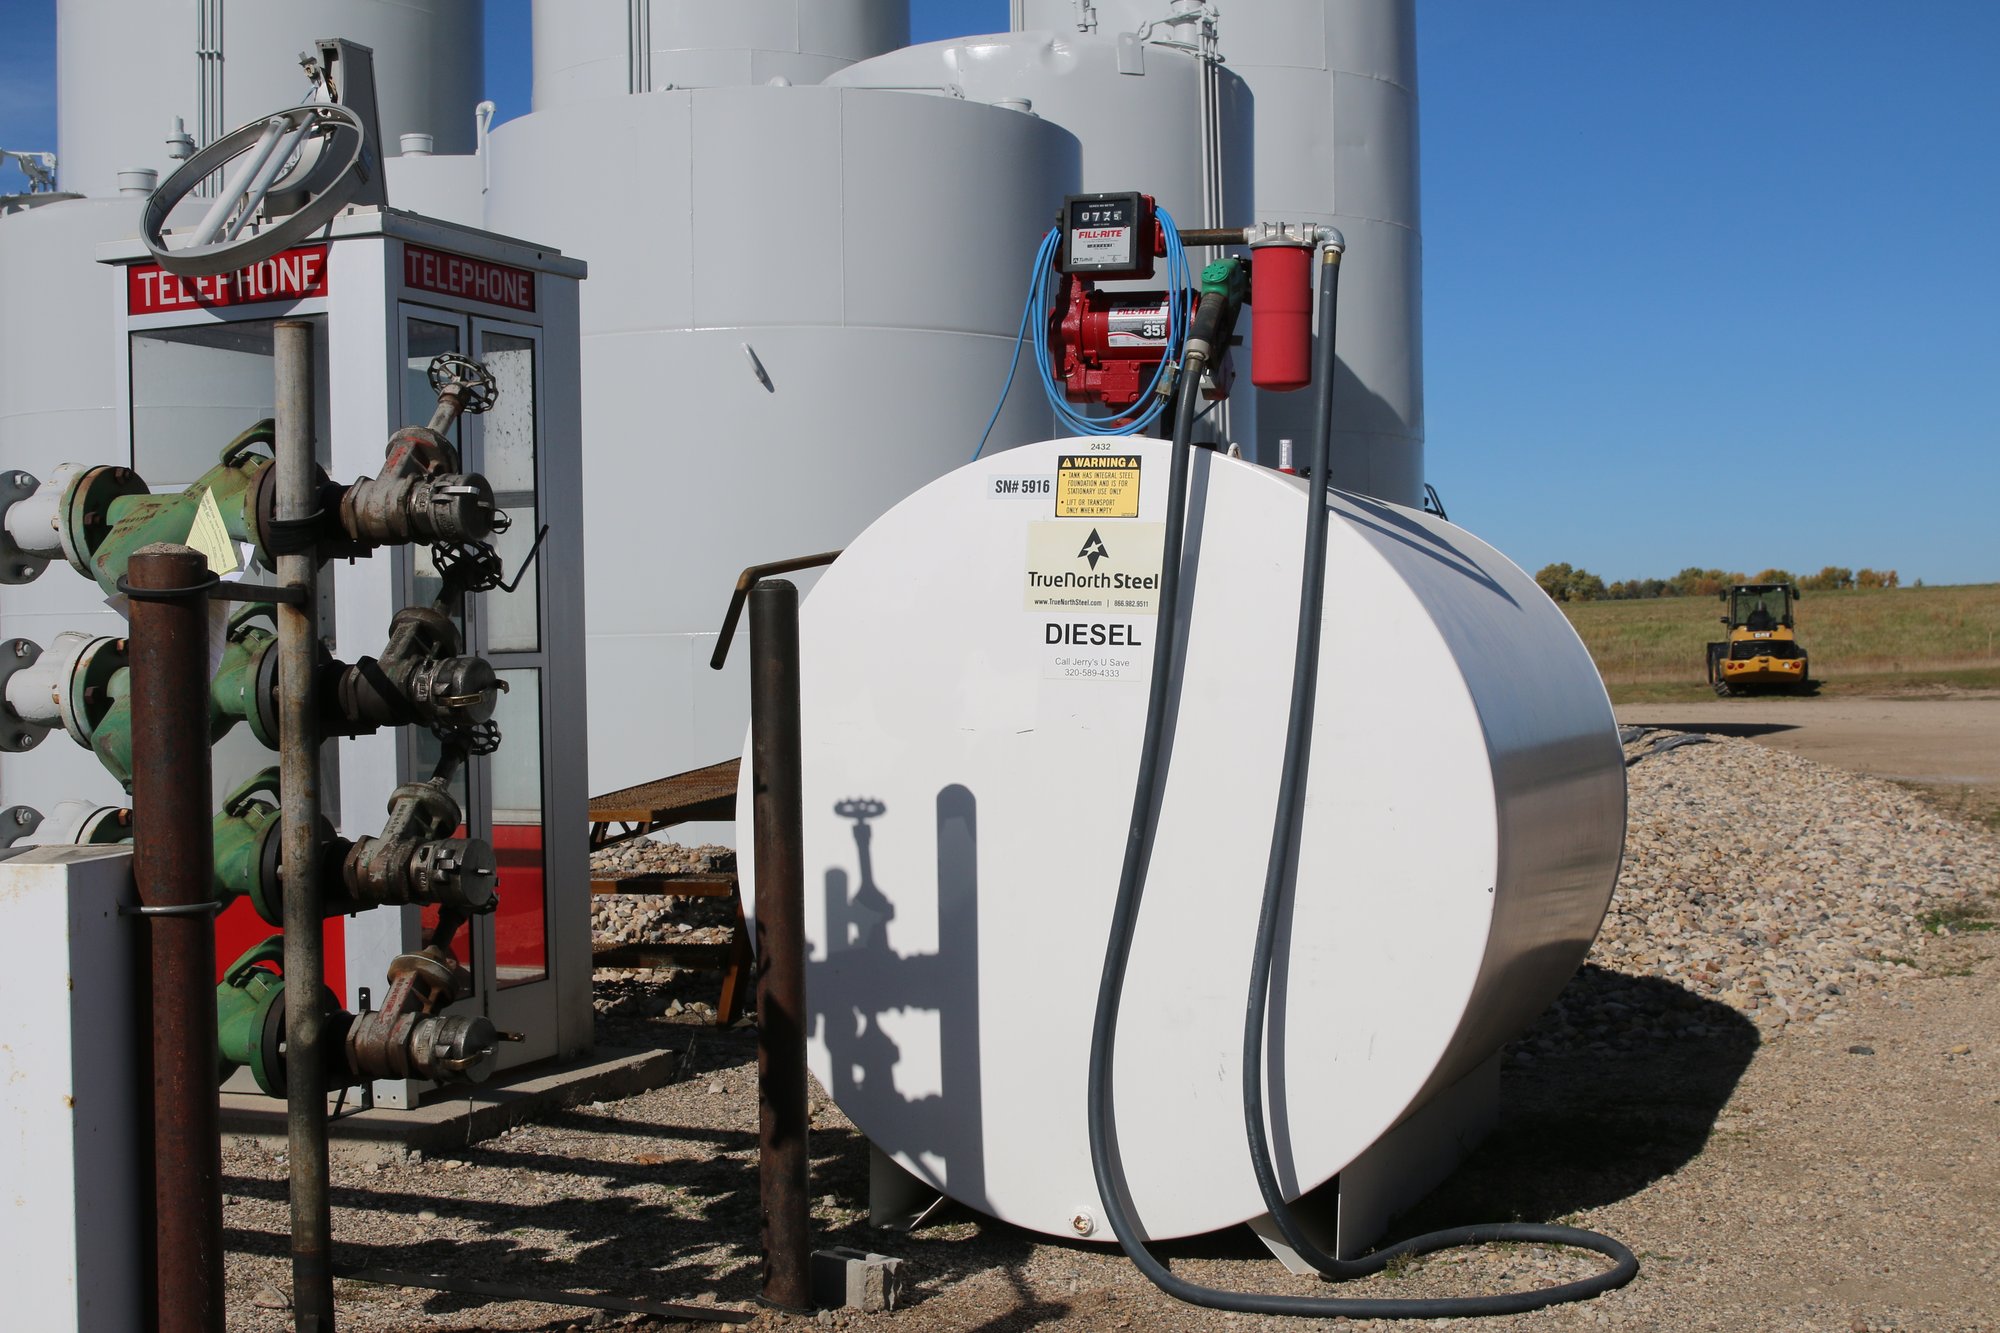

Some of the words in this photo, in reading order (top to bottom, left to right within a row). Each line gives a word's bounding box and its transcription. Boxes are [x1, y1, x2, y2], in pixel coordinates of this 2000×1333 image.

[1079, 230, 1122, 239] FILL-RITE
[138, 254, 321, 307] TELEPHONE
[407, 250, 529, 306] TELEPHONE
[1074, 457, 1126, 468] WARNING
[995, 479, 1019, 494] SN#
[1021, 479, 1050, 494] 5916
[1113, 573, 1158, 589] Steel
[1034, 598, 1102, 607] www.TrueNorthSteel.com
[1114, 600, 1149, 608] 866.982.9511
[1045, 623, 1142, 646] DIESEL
[1055, 657, 1070, 666] Call
[1072, 658, 1098, 668] Jerry's
[1101, 658, 1107, 666] U
[1109, 658, 1130, 667] Save
[1065, 668, 1120, 678] 320-589-4333
